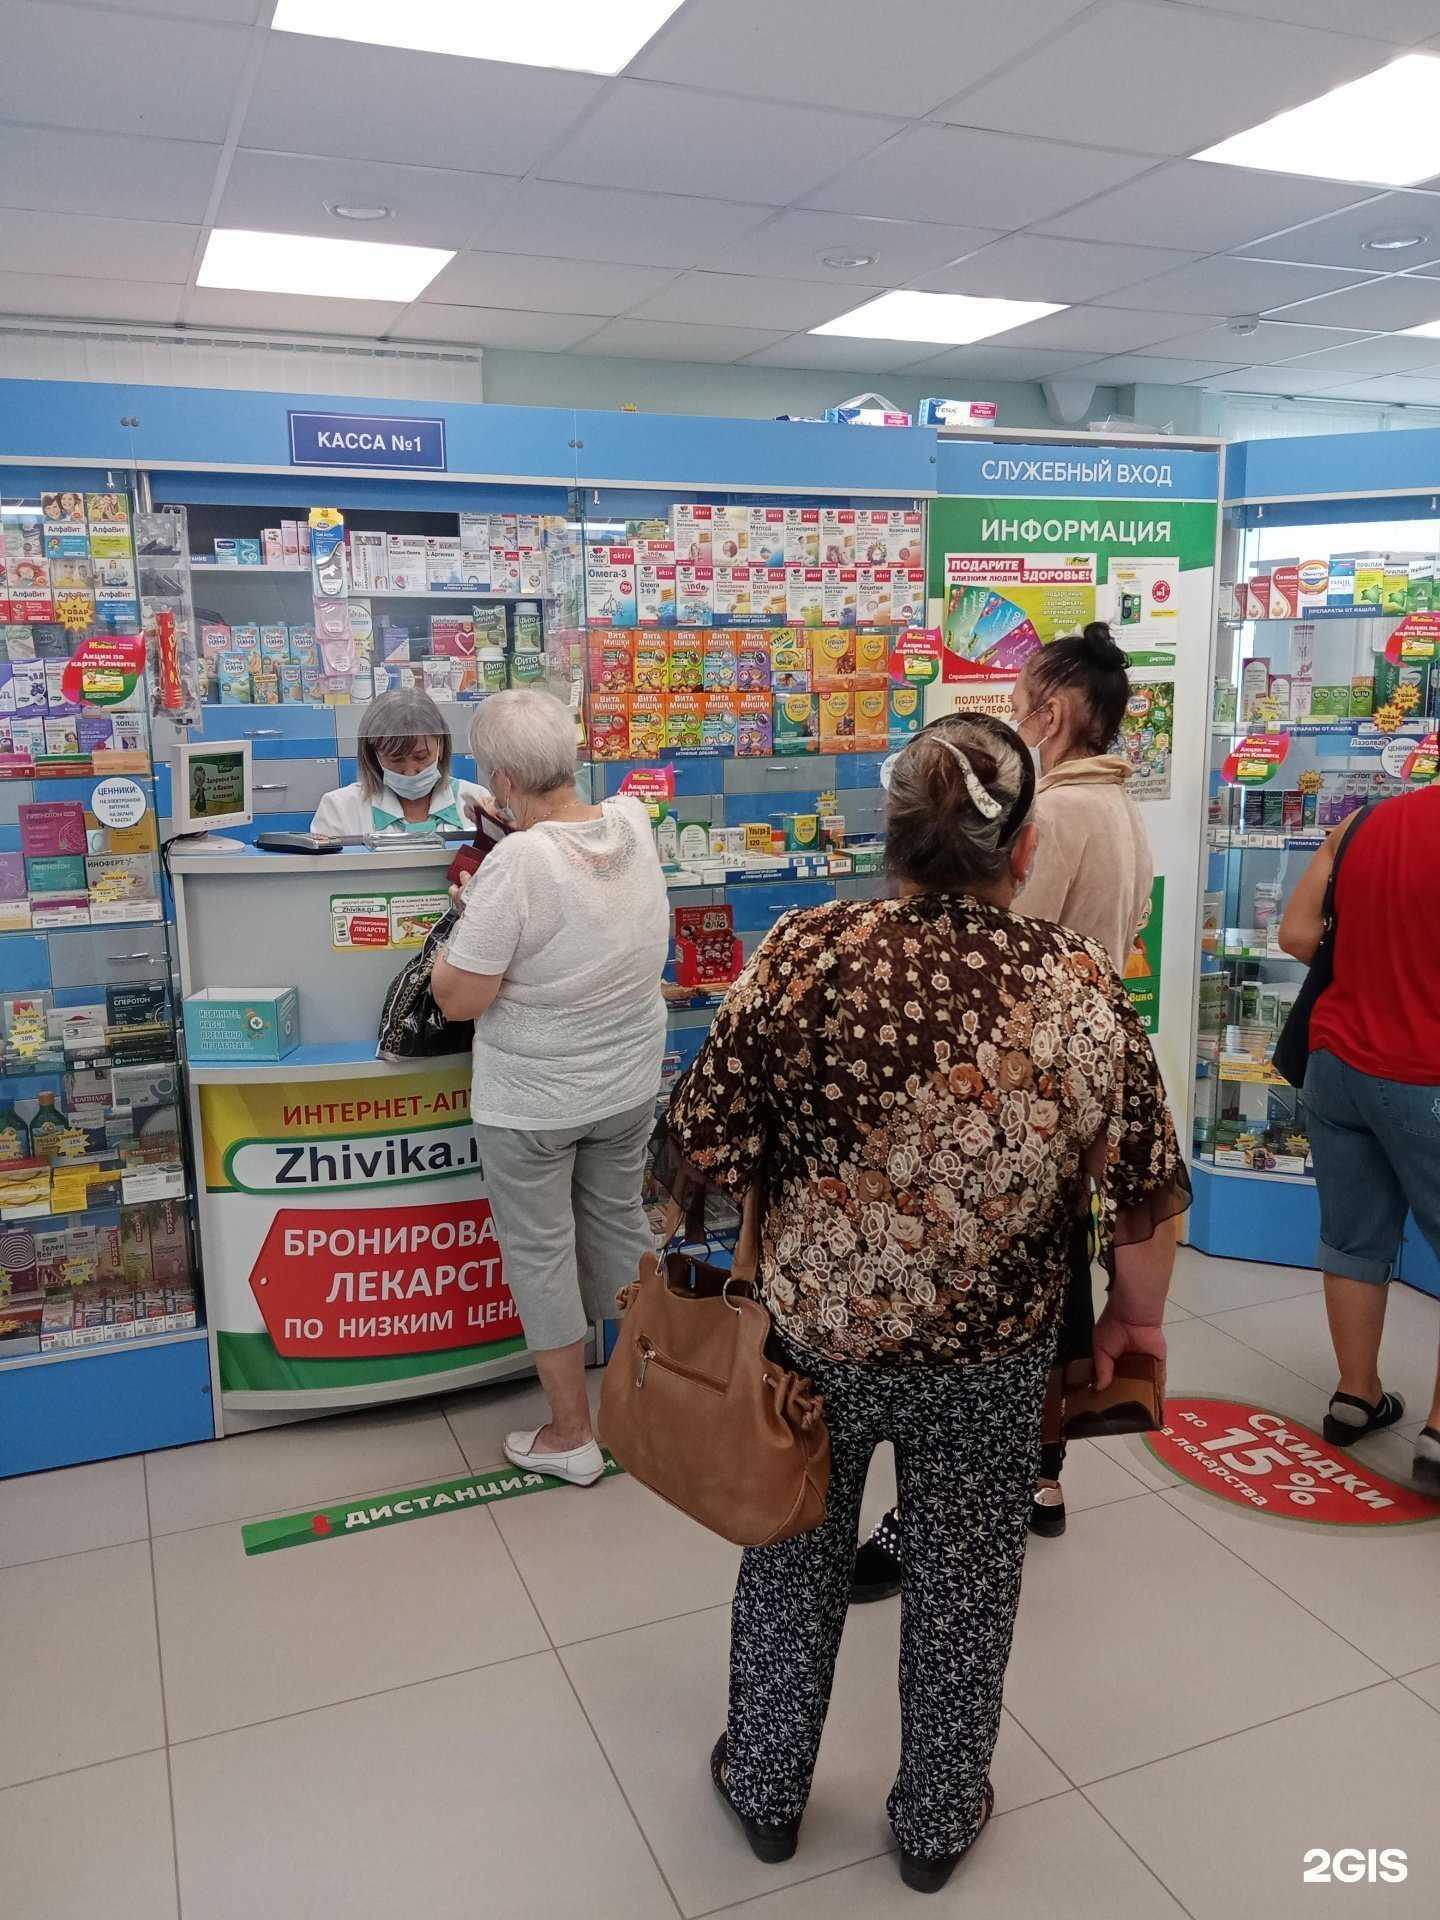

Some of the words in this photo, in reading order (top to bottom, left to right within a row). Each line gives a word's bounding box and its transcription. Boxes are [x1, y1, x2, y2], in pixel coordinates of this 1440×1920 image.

[317, 431, 387, 450] КАССА
[391, 434, 422, 452] №1
[981, 459, 1112, 483] СЛУЖЕБНЫЙ
[1117, 464, 1172, 487] ВХОД
[981, 518, 1172, 545] ИНФОРМАЦИЯ
[588, 569, 627, 578] Омега-3
[951, 560, 1019, 571] ПОДАРИТЕ
[1022, 570, 1090, 582] ЗДОРОВЬЕ!
[83, 653, 112, 661] Акции
[99, 660, 136, 668] Клиента
[514, 657, 538, 666] Фито
[955, 695, 1005, 705] ПОЛУЧИТЕ
[283, 1087, 472, 1126] ИНТЕРНЕТ-АП
[285, 1318, 323, 1339] ПО
[338, 1310, 453, 1339] НИЗКИМ
[1171, 1436, 1268, 1507] лекарства
[1178, 1411, 1208, 1428] до
[1200, 1426, 1295, 1476] 15
[1272, 1472, 1333, 1506] %
[1248, 1413, 1395, 1510] СКИДКИ
[344, 1472, 544, 1529] ДИСТАНЦИЯ
